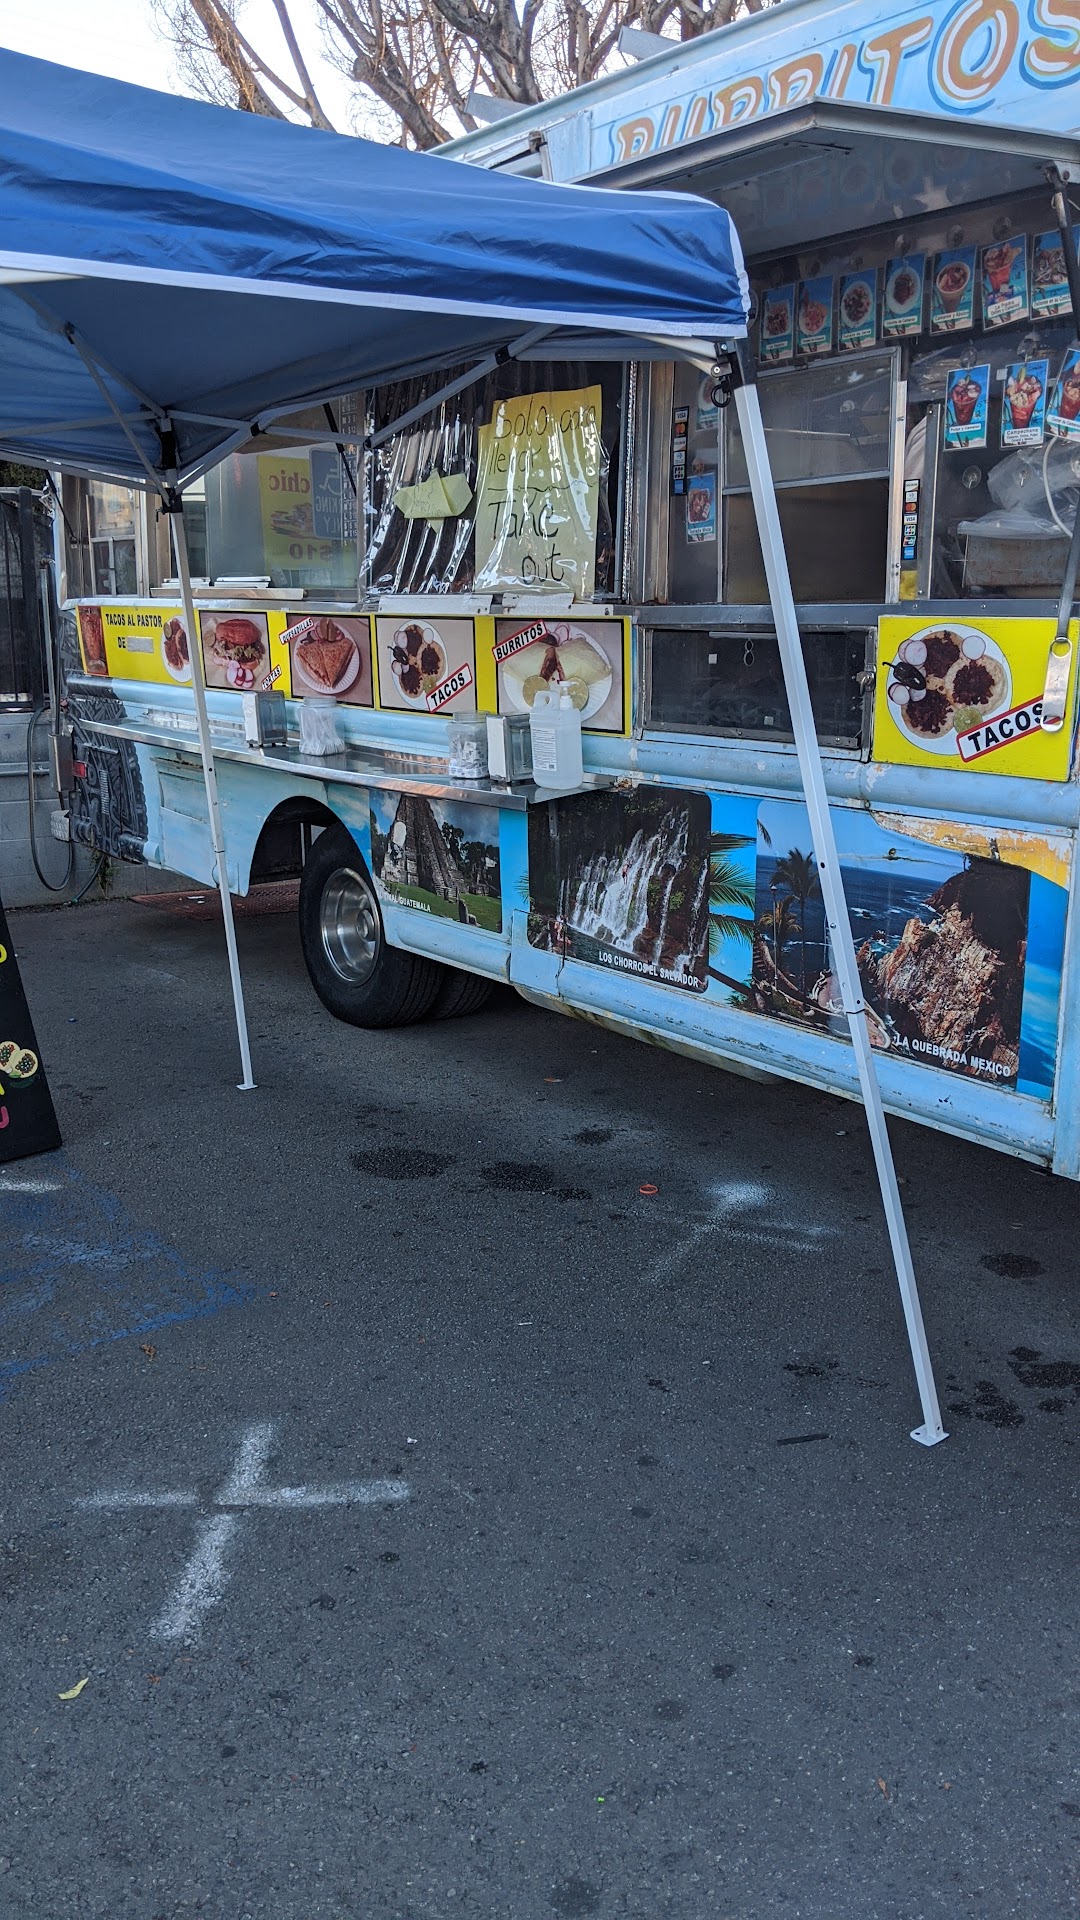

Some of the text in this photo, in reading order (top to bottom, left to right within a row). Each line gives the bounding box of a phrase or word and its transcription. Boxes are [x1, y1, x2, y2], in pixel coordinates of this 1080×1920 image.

[488, 492, 559, 540] Take
[105, 614, 163, 628] TACOS AL PASTOR
[282, 618, 314, 643] QUESADILLAS
[117, 637, 126, 649] DE
[496, 622, 544, 660] BURRITOS
[262, 666, 281, 691] TORTAS
[430, 672, 466, 707] TACOS
[967, 702, 1048, 753] TACOS
[400, 896, 432, 912] GUATEMALA
[599, 951, 612, 964] LOS
[660, 968, 699, 988] SALVADOR
[897, 1033, 1011, 1077] LA QUEBRADA MEXICO
